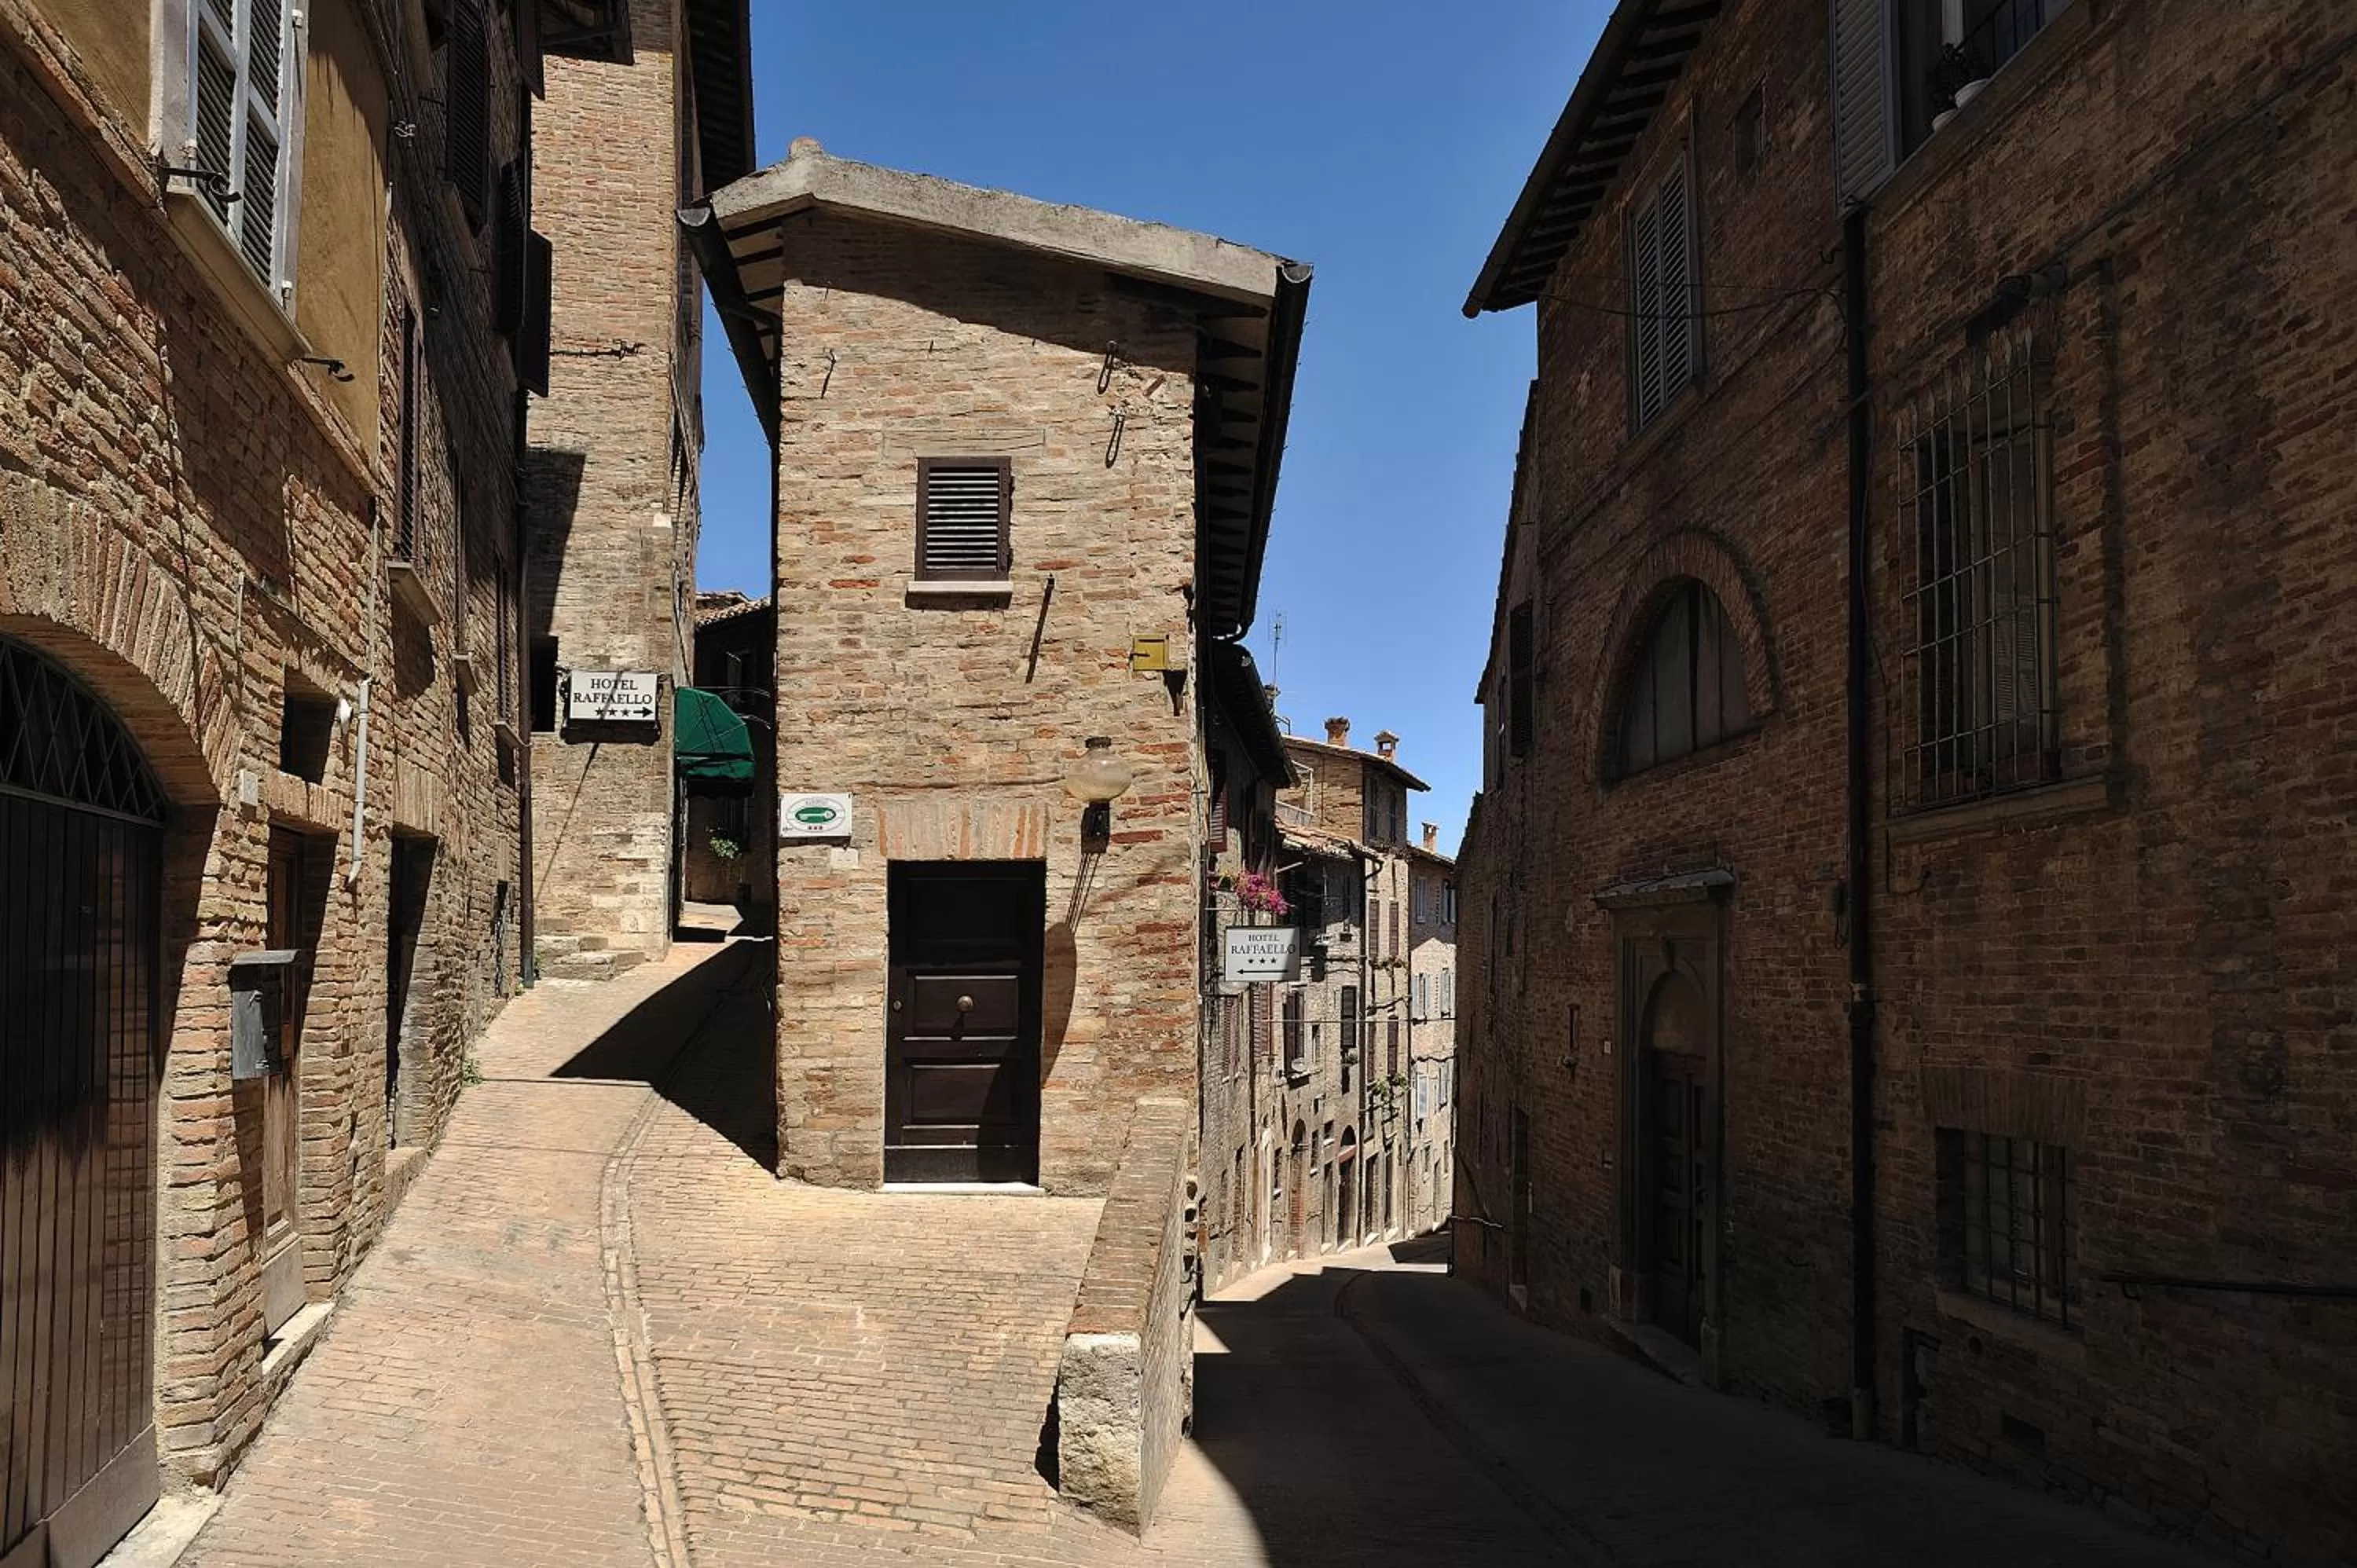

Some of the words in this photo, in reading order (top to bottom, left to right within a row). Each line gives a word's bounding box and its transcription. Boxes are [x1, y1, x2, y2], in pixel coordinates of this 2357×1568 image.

[590, 678, 638, 691] HOTEL
[573, 692, 653, 705] RAFFAELLO
[1248, 933, 1280, 942] HOTEL
[1231, 943, 1296, 954] RAFFAELLO
